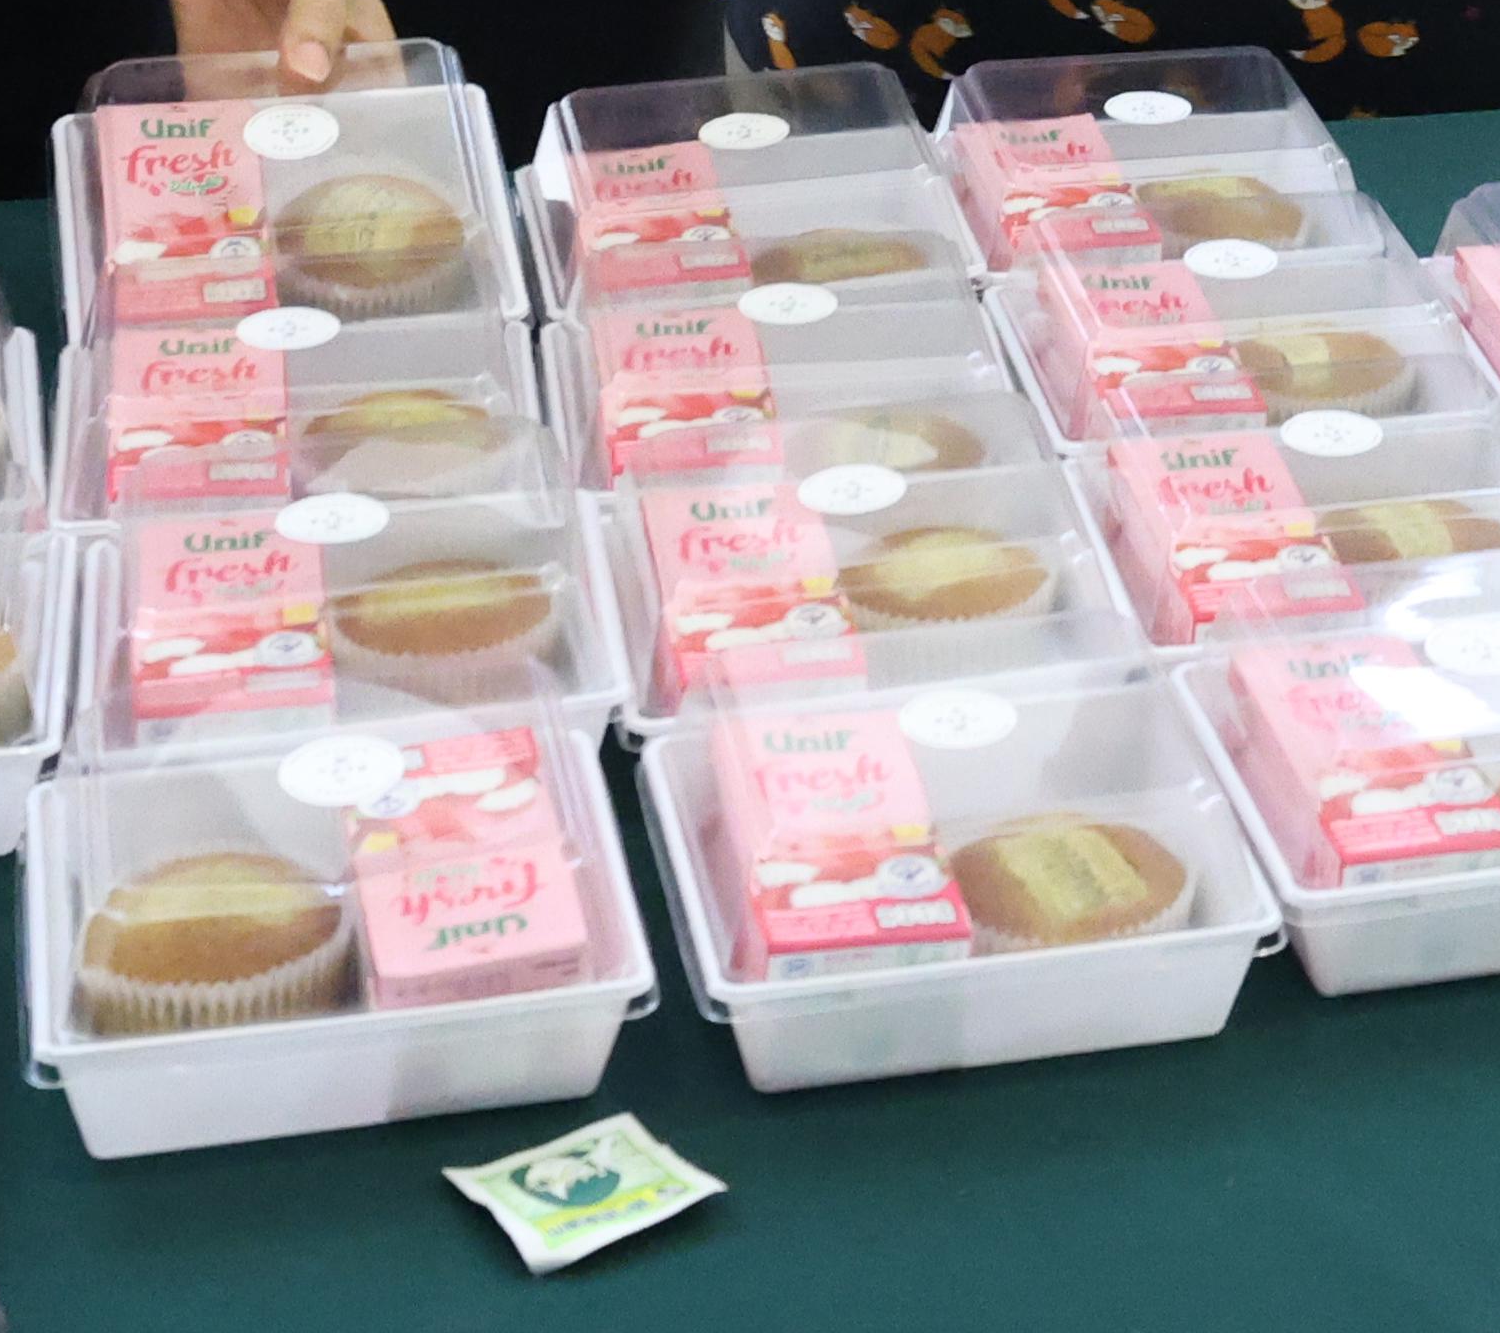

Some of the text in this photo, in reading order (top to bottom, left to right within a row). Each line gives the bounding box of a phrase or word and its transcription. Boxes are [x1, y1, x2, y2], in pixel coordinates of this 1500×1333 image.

[120, 140, 237, 184] fresh
[141, 357, 258, 391] fresh
[1158, 469, 1274, 505] fresh
[679, 519, 800, 563] fresh
[164, 550, 292, 591] fresh
[754, 754, 889, 803] fresh
[392, 862, 550, 924] fresh
